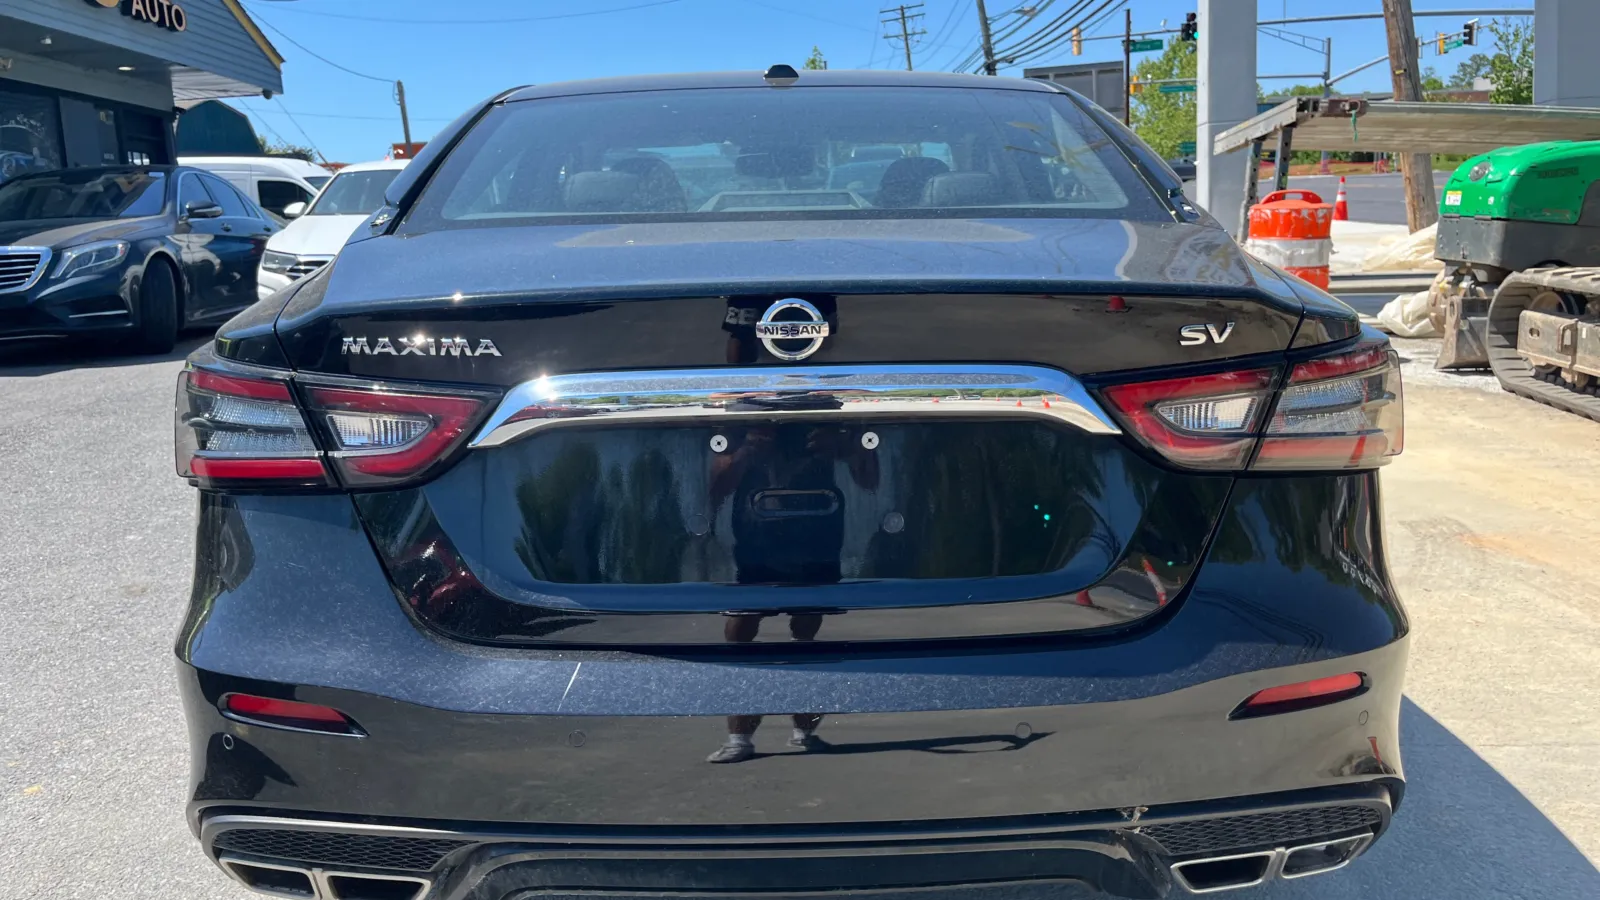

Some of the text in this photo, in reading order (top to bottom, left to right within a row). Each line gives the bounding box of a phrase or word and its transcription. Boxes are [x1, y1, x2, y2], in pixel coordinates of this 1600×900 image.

[131, 0, 186, 31] AUTO
[764, 325, 822, 337] NISSAN
[1180, 322, 1235, 346] SV
[341, 336, 503, 357] MAXIMA
